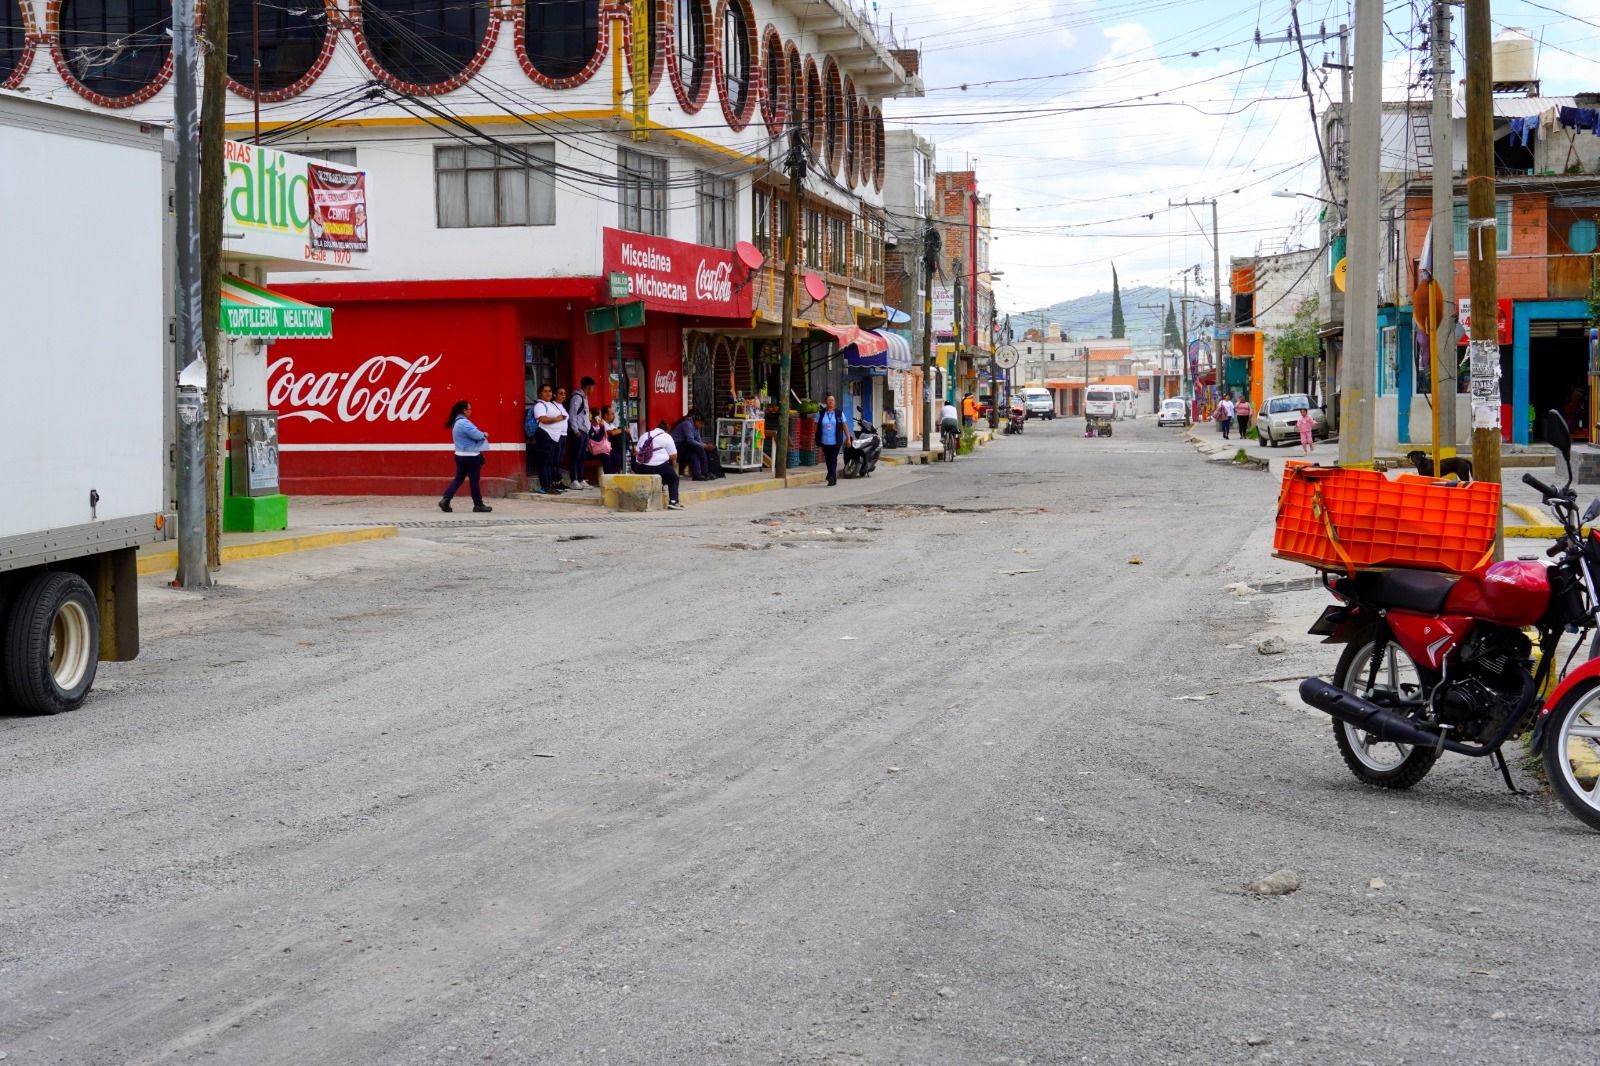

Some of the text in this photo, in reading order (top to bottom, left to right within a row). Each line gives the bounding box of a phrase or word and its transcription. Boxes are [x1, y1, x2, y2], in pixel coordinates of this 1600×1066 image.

[223, 148, 309, 230] altic
[304, 244, 352, 264] Desde 1970
[621, 243, 671, 272] Miscelánea
[635, 273, 688, 302] Michoacana
[283, 309, 324, 329] NEALTICAN
